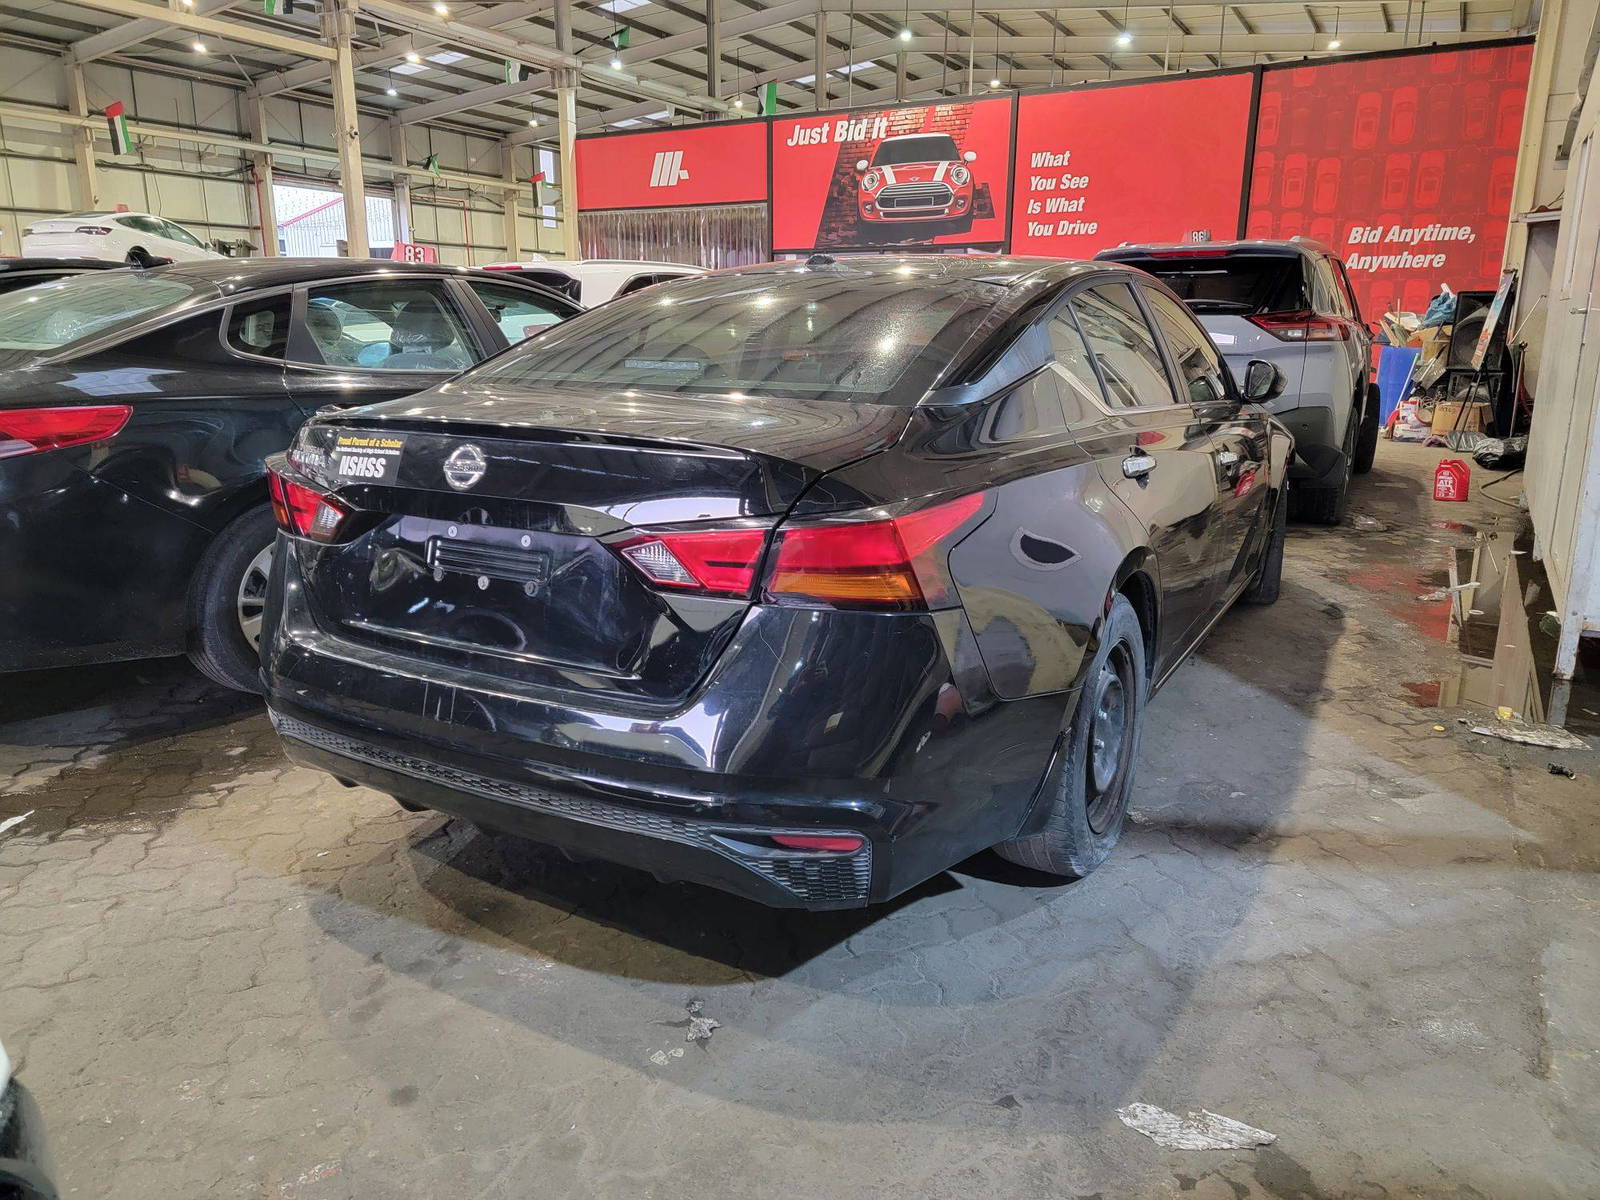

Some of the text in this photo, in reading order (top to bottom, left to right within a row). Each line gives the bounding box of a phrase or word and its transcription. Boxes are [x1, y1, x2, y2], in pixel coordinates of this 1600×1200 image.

[787, 117, 888, 146] Just Bid It
[1030, 150, 1070, 168] What
[1030, 174, 1089, 191] You See
[1027, 197, 1085, 214] Is What
[1027, 220, 1098, 237] You Drive
[1348, 224, 1476, 246] Bid Anytime,
[405, 245, 425, 262] 83
[1345, 251, 1447, 273] Anywhere
[339, 456, 386, 478] NSHSS
